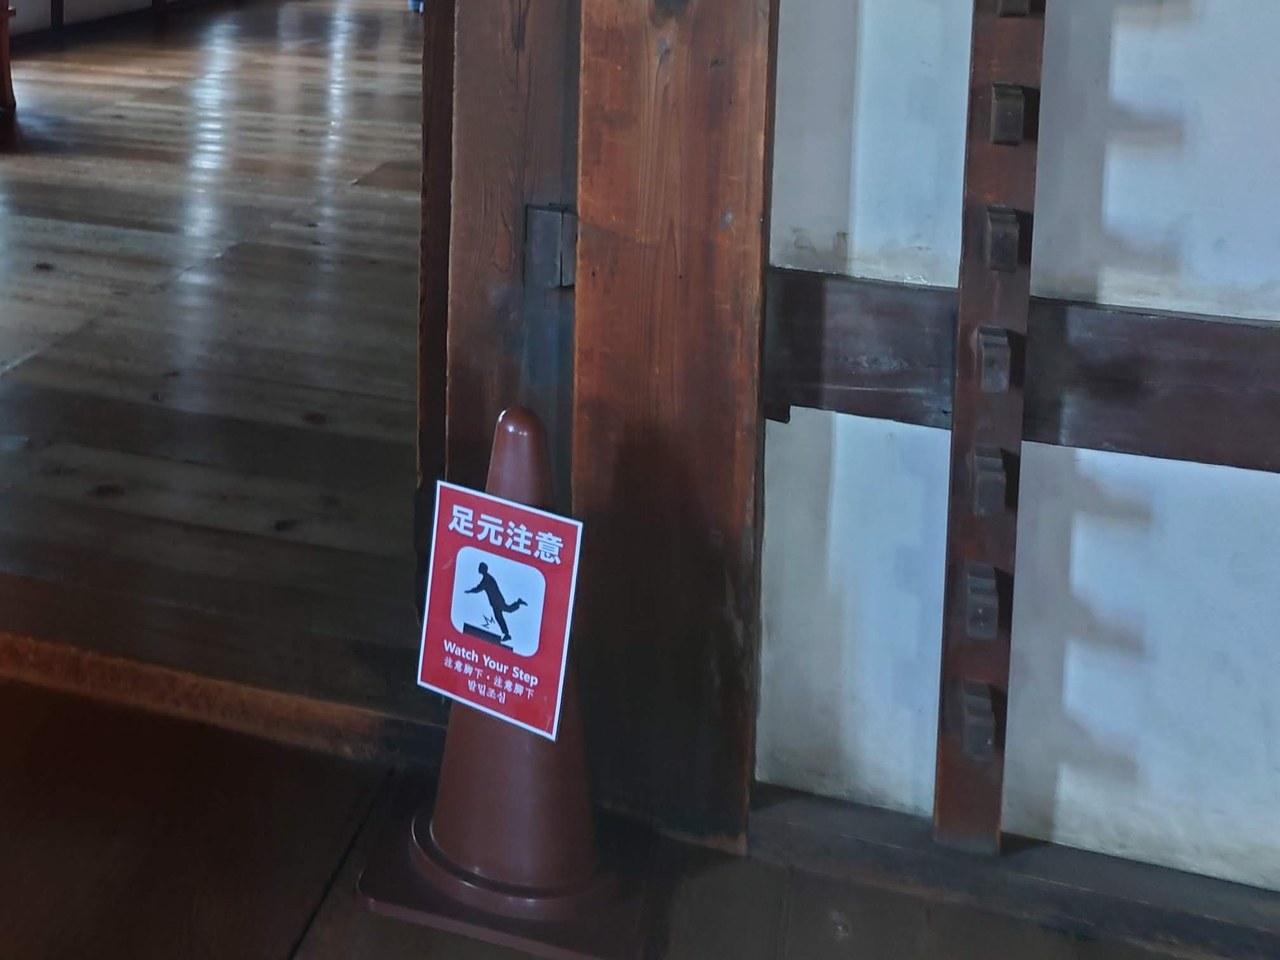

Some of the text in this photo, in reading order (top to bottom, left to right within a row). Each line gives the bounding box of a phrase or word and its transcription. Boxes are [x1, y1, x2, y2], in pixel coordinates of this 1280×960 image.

[449, 505, 563, 565] 足元注意
[444, 640, 538, 687] Watch Your Step
